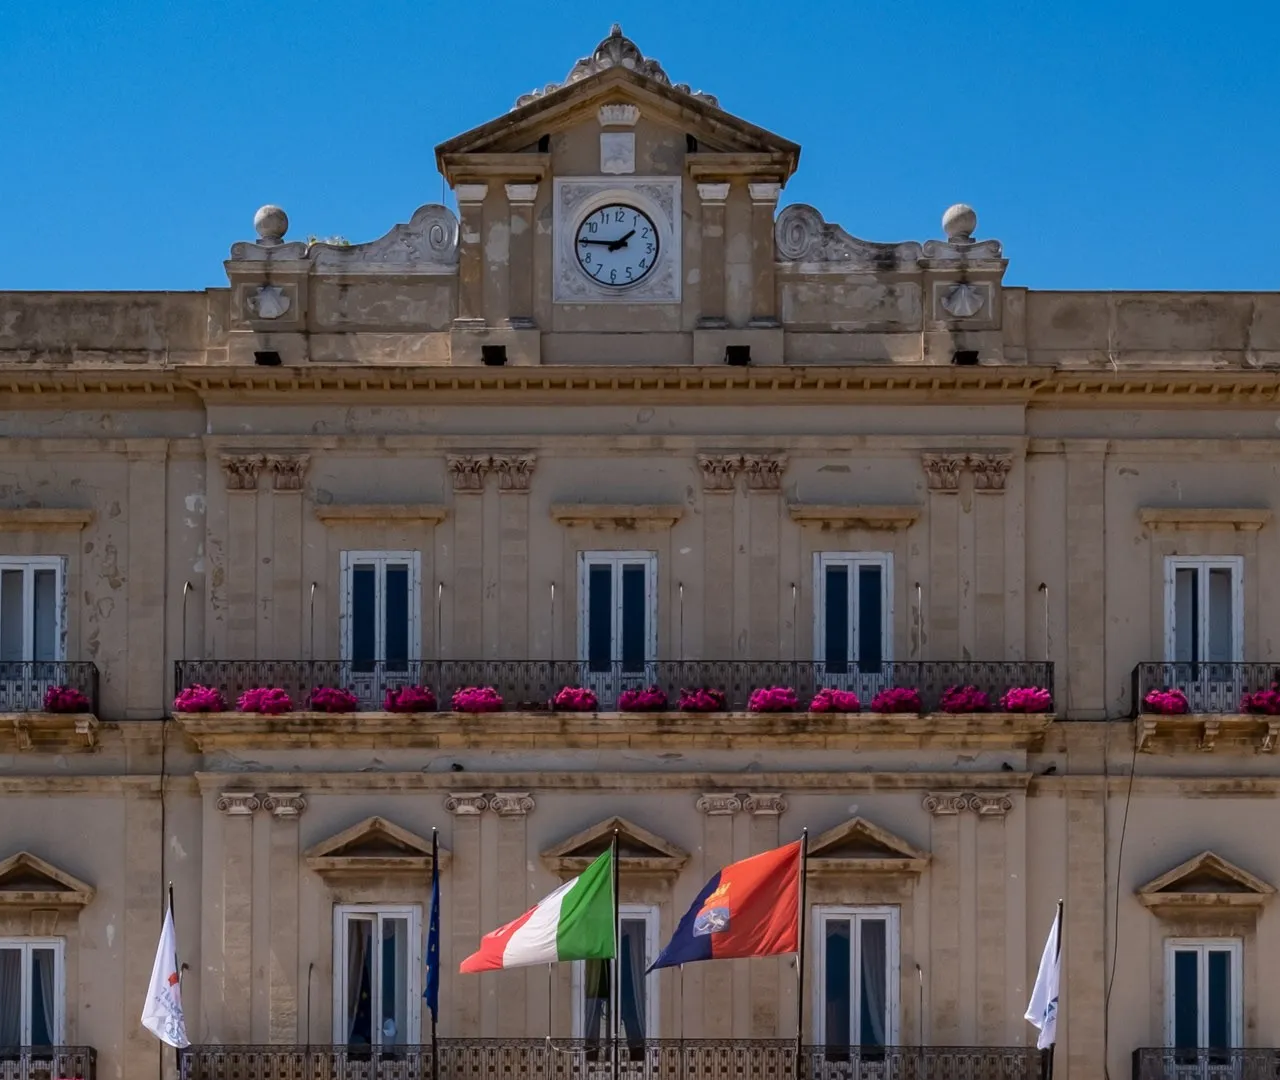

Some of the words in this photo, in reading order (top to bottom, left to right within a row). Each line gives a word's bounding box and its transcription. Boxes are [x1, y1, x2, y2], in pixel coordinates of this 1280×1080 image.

[601, 213, 609, 224] 11
[615, 211, 625, 222] 12
[588, 222, 598, 233] 10
[641, 227, 649, 239] 2
[646, 243, 653, 254] 3
[585, 252, 592, 264] 8
[638, 258, 646, 269] 4
[595, 263, 603, 275] 7
[610, 269, 617, 280] 6
[625, 267, 632, 278] 5
